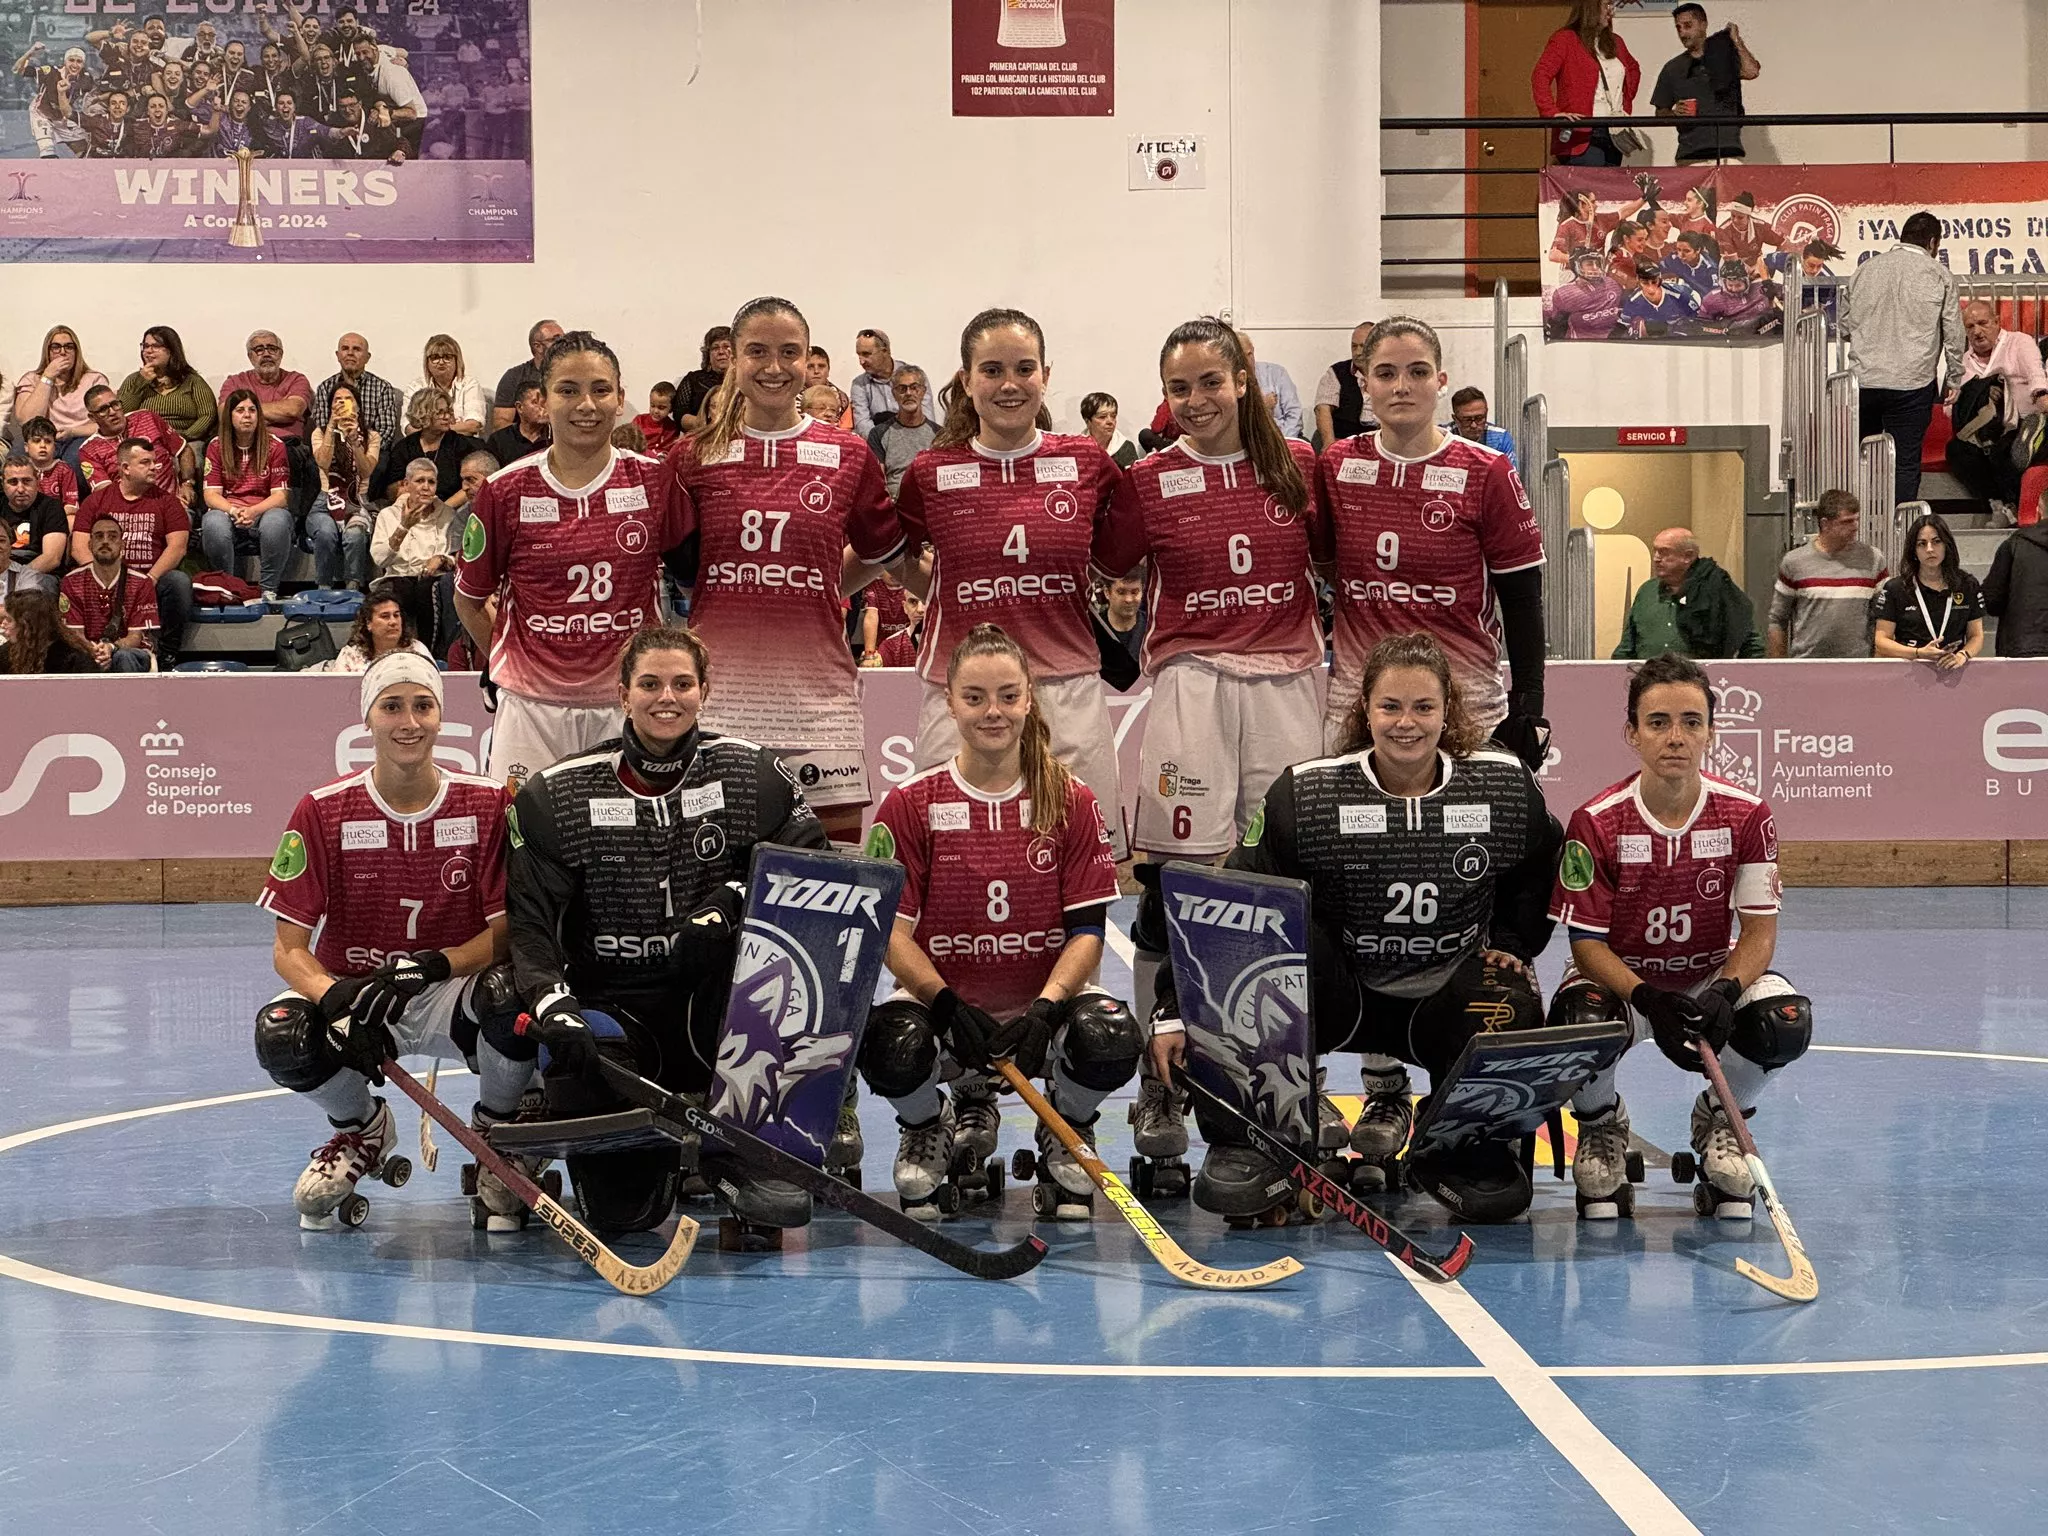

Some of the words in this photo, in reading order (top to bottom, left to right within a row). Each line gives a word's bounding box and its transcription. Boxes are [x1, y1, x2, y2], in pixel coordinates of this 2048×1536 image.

[989, 62, 1016, 71] PRIMERA
[1018, 62, 1048, 71] CAPITANA
[1049, 62, 1060, 71] DEL
[1061, 62, 1078, 71] CLUB
[961, 74, 985, 83] PRIMER
[986, 74, 997, 83] GOL
[999, 74, 1028, 83] MARCADO
[1030, 74, 1037, 83] DE
[1039, 74, 1047, 83] LA
[1048, 74, 1076, 83] HISTORIA
[1077, 74, 1088, 83] DEL
[1090, 74, 1106, 83] CLUB
[971, 87, 982, 95] 102
[984, 87, 1013, 95] PARTIDOS
[1014, 87, 1027, 95] CON
[1028, 87, 1036, 95] LA
[1037, 87, 1067, 95] CAMISETA
[1068, 87, 1080, 95] DEL
[1081, 87, 1097, 95] CLUB
[115, 169, 398, 206] WINNERS
[184, 215, 200, 228] A
[203, 214, 272, 228] Cora
[279, 214, 328, 228] 2024
[468, 208, 519, 216] CHAMPIONS
[1780, 205, 1797, 222] CLUB
[1820, 212, 1834, 239] FRAGA
[1938, 217, 2012, 239] OMOS
[1626, 432, 1666, 441] SERVICIO
[939, 470, 979, 481] Huesca
[1036, 464, 1076, 474] Huesca
[1342, 466, 1377, 476] Huesca
[1425, 473, 1464, 485] Huesca
[1162, 475, 1202, 489] Huesca
[122, 532, 152, 541] PEONAS
[740, 510, 792, 553] 87
[1002, 525, 1030, 563] 4
[1228, 533, 1252, 574] 6
[1376, 531, 1400, 571] 9
[121, 550, 153, 560] PEONAS
[566, 561, 613, 604] 28
[706, 585, 763, 594] USINESS
[774, 587, 827, 599] SCHOOL
[957, 574, 1077, 604] esneca
[1184, 581, 1295, 612] esneca
[526, 607, 643, 634] esneca
[1773, 729, 1854, 754] Fraga
[146, 763, 217, 781] Consejo
[1180, 776, 1201, 785] Fraga
[1772, 761, 1893, 780] Ayuntamiento
[147, 781, 222, 800] Superior
[1772, 783, 1872, 802] Ajuntament
[146, 799, 168, 814] de
[173, 799, 253, 818] Deportes
[592, 806, 634, 816] Huesca
[1341, 813, 1385, 824] Huesca
[1446, 813, 1489, 823] Huesca
[436, 827, 476, 838] Huesca
[1172, 805, 1192, 840] 6
[342, 829, 385, 840] Huesca
[1621, 843, 1650, 852] esca
[659, 875, 674, 918] 1
[763, 873, 882, 932] TOOR
[986, 880, 1010, 922] 8
[1383, 882, 1439, 924] 26
[399, 898, 424, 940] 7
[1172, 891, 1295, 951] TOOR
[1644, 903, 1692, 945] 85
[928, 928, 1066, 956] esneca
[837, 927, 864, 983] 1
[1622, 949, 1729, 971] sneca
[1367, 1078, 1398, 1089] SIOUX
[1290, 1162, 1389, 1246] AZEMAD
[537, 1203, 601, 1267] SUPER
[615, 1246, 685, 1291] AZEMAD
[1174, 1262, 1266, 1285] AZEMAD
